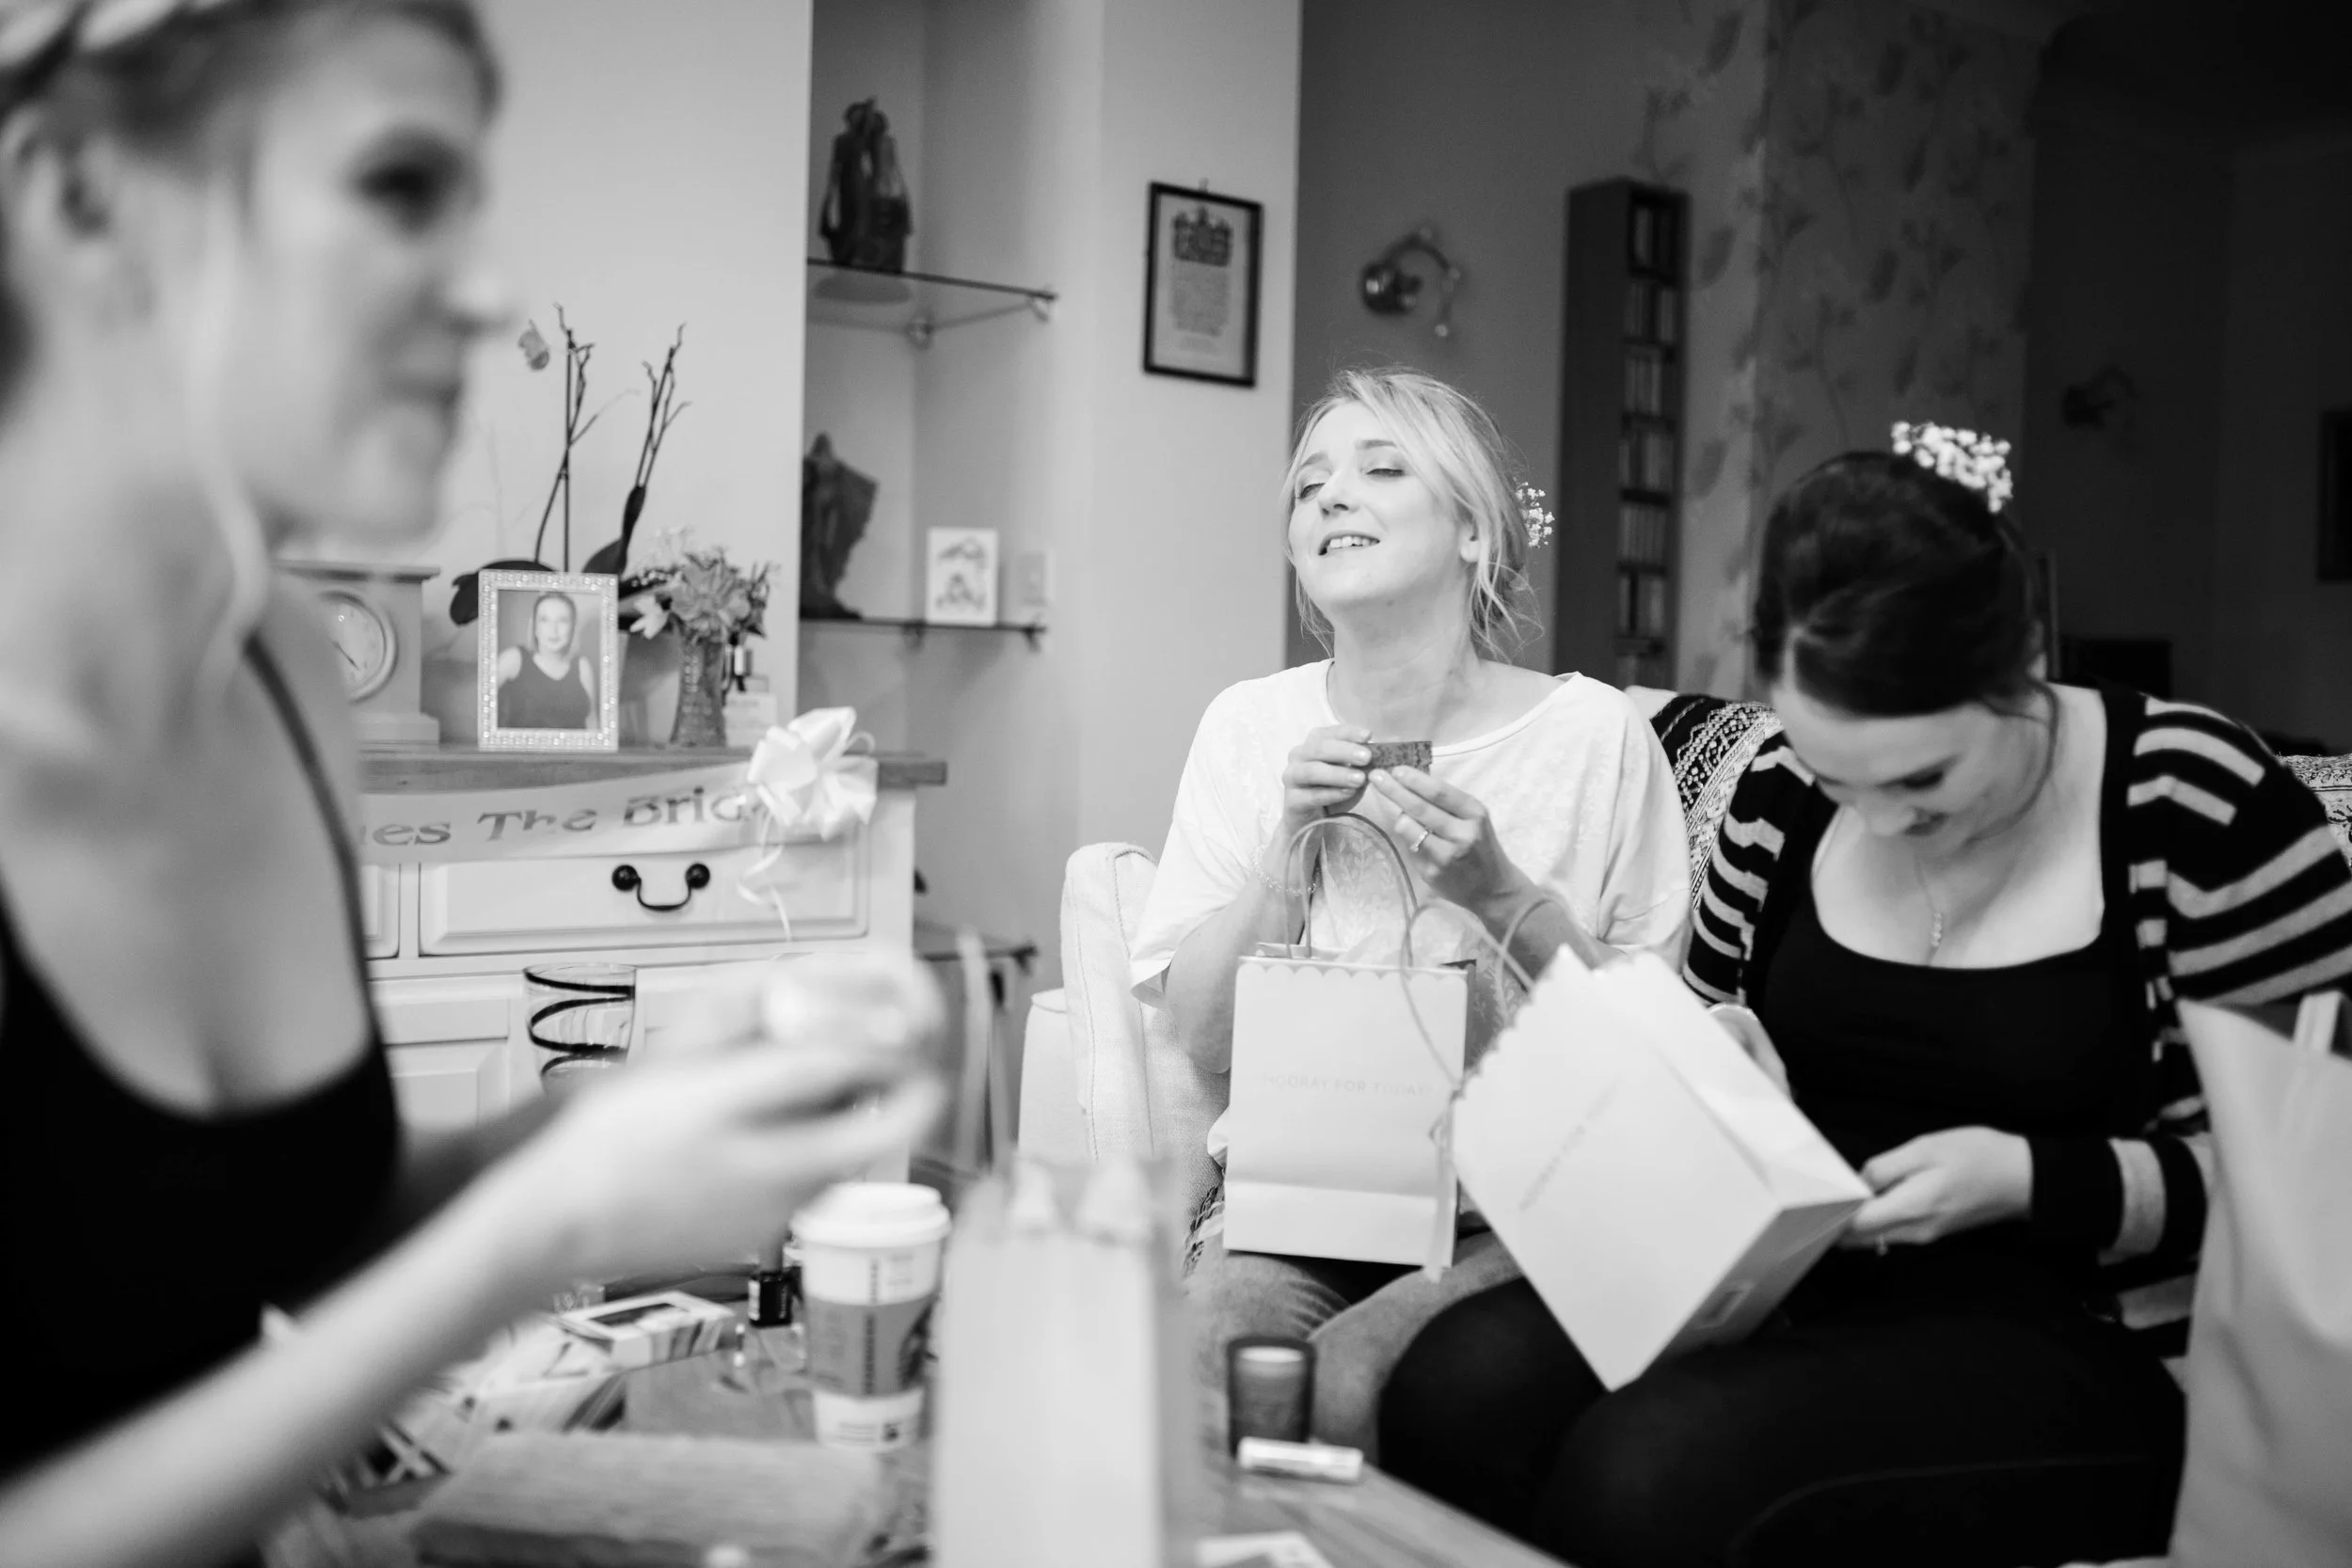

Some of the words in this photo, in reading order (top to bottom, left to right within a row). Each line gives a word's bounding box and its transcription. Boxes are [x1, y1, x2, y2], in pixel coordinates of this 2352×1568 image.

[361, 820, 452, 846] es
[477, 808, 598, 843] The
[624, 785, 765, 827] Brid
[1263, 1072, 1328, 1090] HOORAY
[1334, 1078, 1367, 1093] FOR
